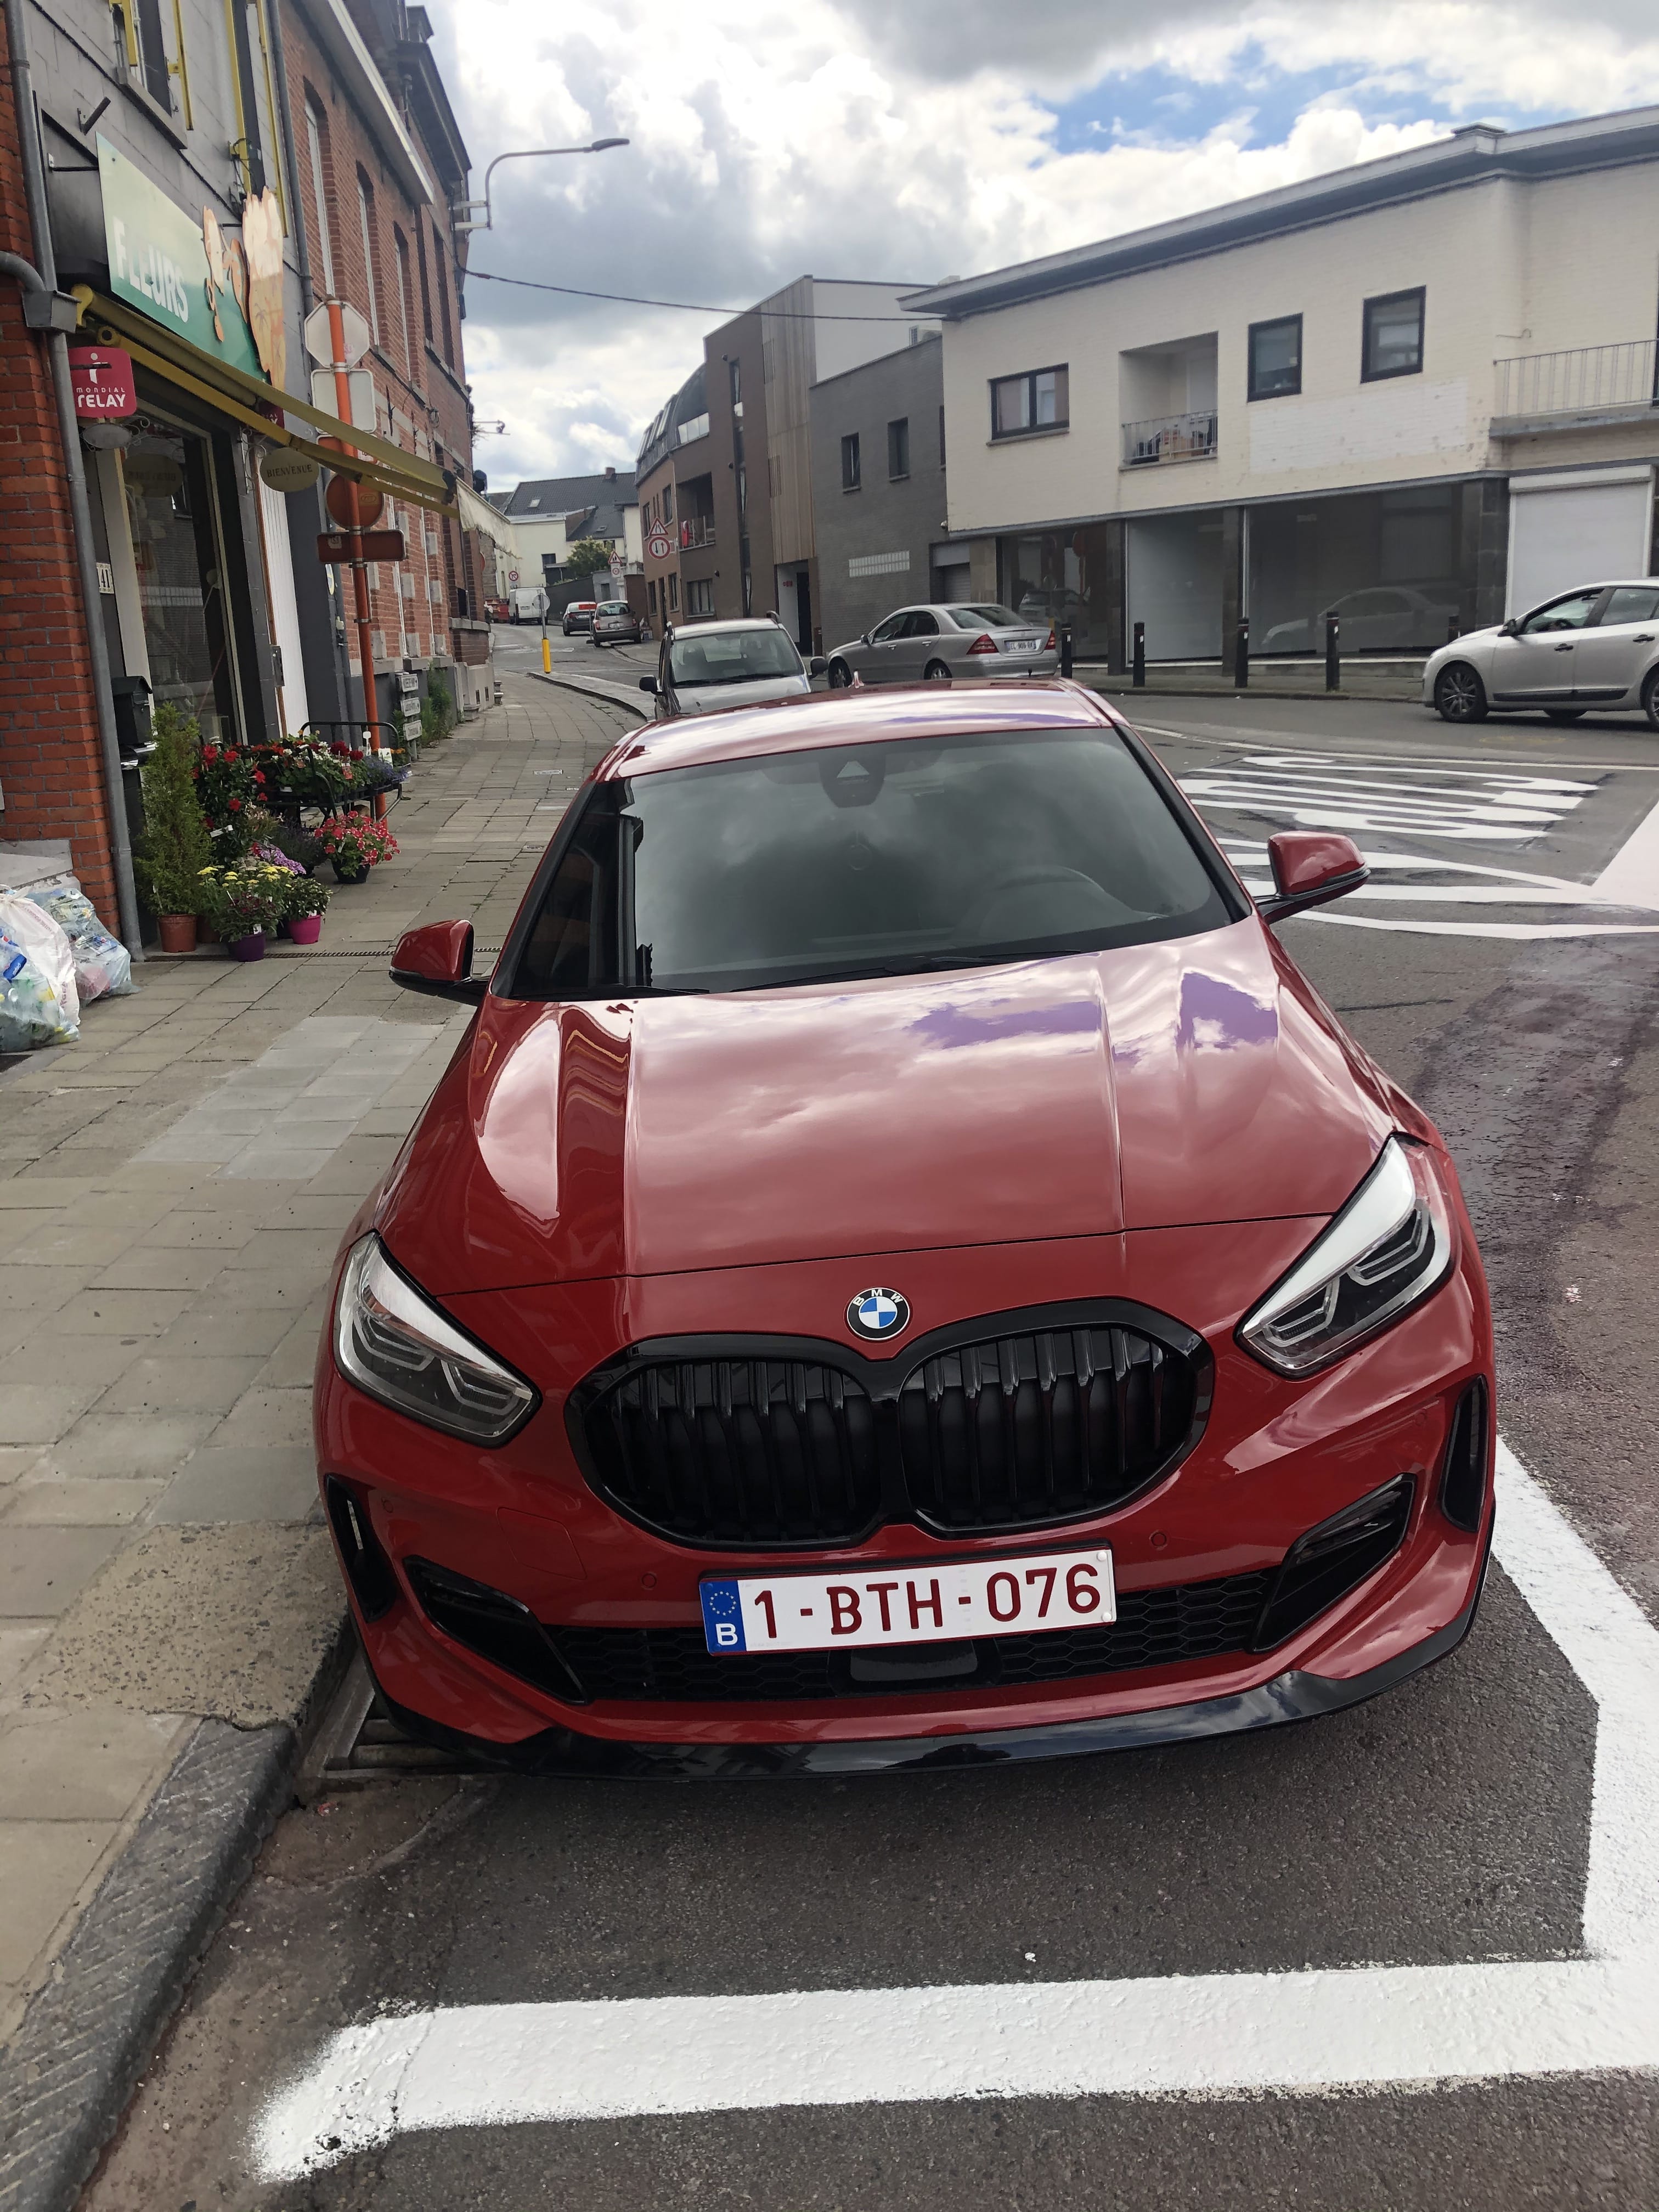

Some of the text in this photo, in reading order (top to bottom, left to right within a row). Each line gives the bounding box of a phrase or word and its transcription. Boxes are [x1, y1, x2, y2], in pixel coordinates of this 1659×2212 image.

[113, 216, 188, 323] FLEURS
[267, 464, 313, 478] BIENVENUE
[99, 569, 110, 588] 41
[853, 1289, 904, 1307] BMW
[715, 1563, 1101, 1645] B 1-BTH-076
